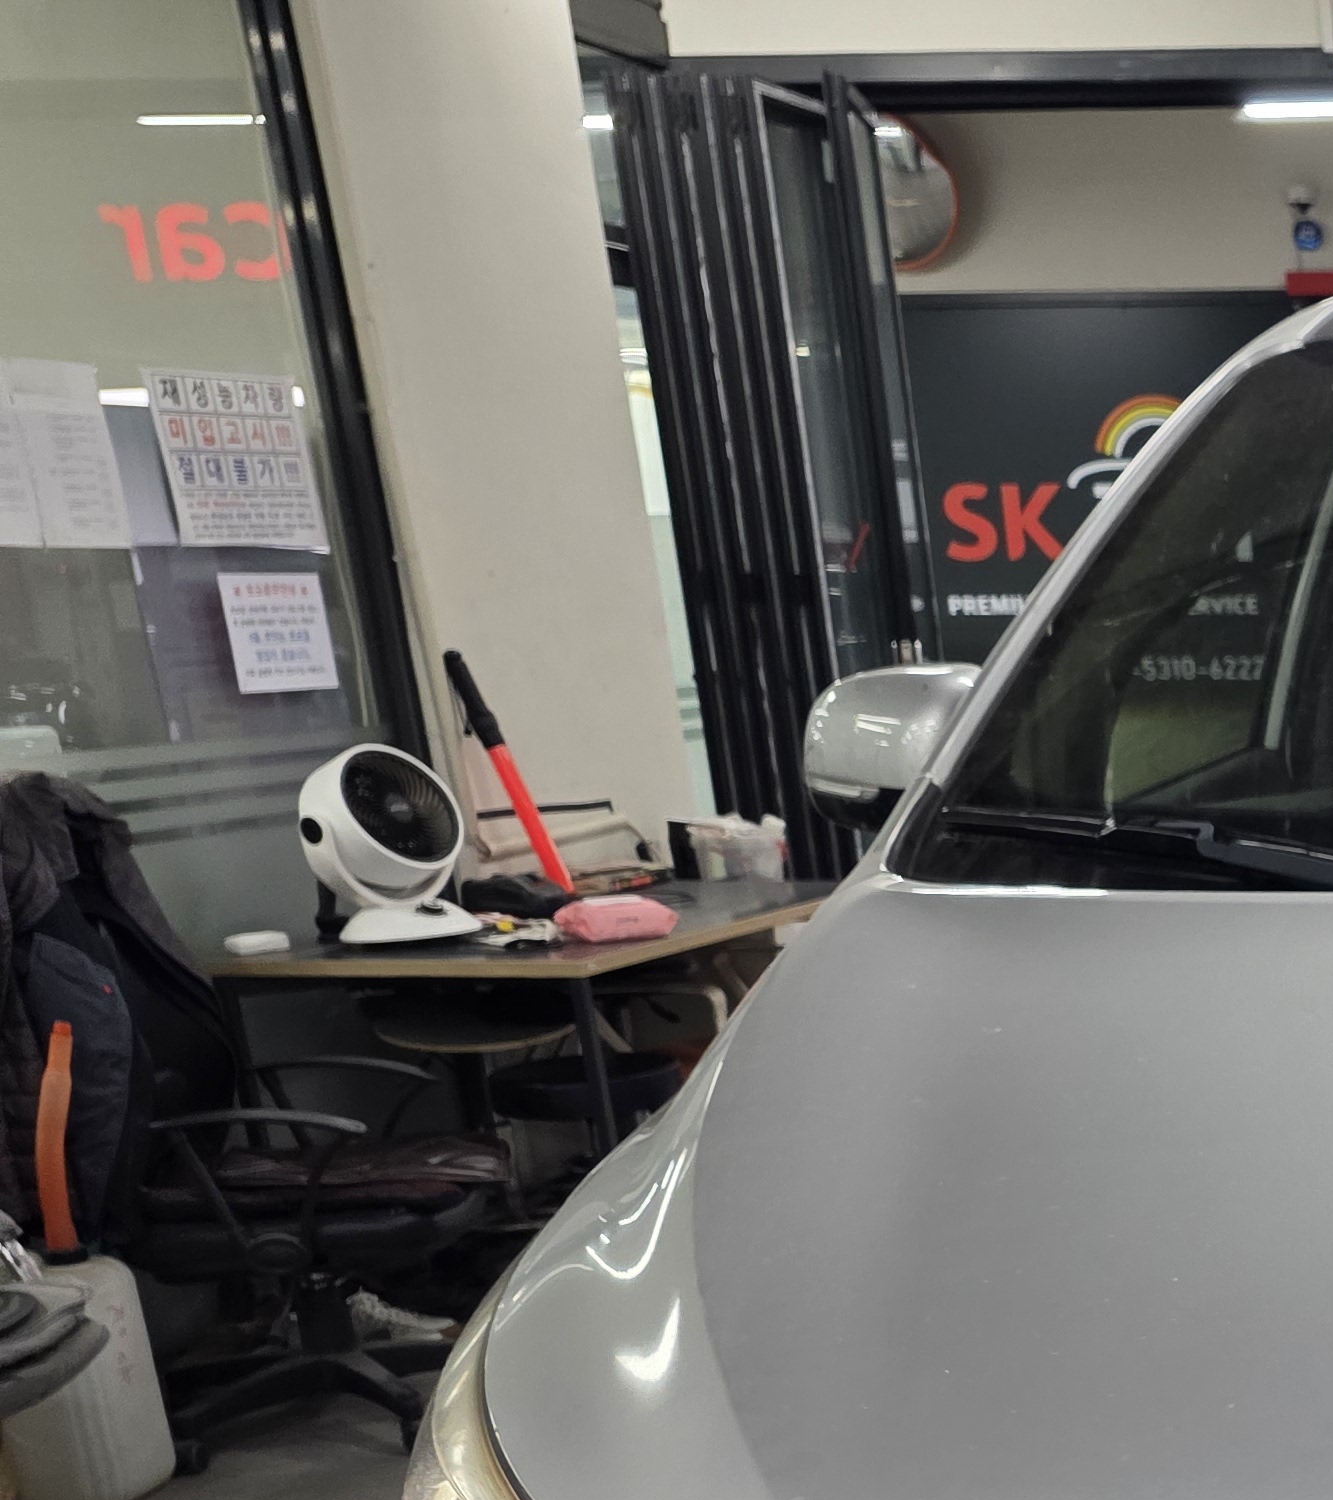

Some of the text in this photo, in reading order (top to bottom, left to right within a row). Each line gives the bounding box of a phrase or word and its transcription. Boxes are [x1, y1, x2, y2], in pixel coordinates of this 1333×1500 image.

[943, 481, 1065, 562] SK
[947, 594, 1259, 616] PREMI RVICE
